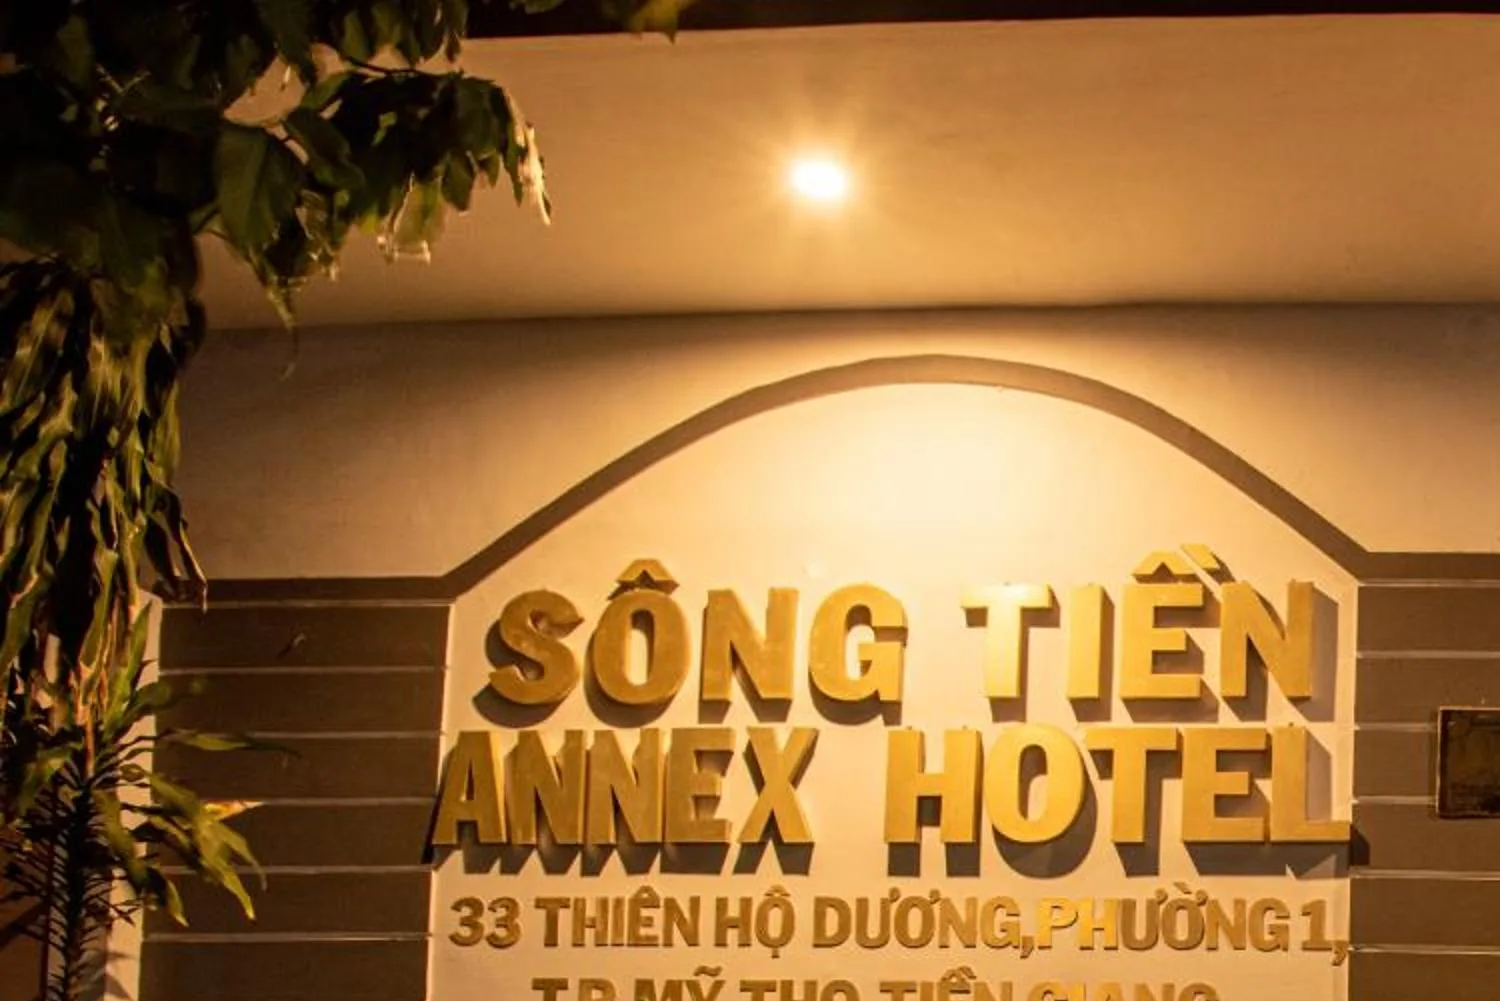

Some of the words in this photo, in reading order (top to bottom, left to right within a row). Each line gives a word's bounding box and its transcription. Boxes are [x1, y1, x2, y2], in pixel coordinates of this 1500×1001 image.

[488, 558, 908, 704] SÔNG
[960, 543, 1314, 701] TIỀN
[431, 727, 818, 845] ANNEX
[883, 721, 1351, 844] HOTEL
[448, 896, 523, 949] 33
[534, 885, 701, 948] THIÊN
[713, 884, 796, 959] HỘ
